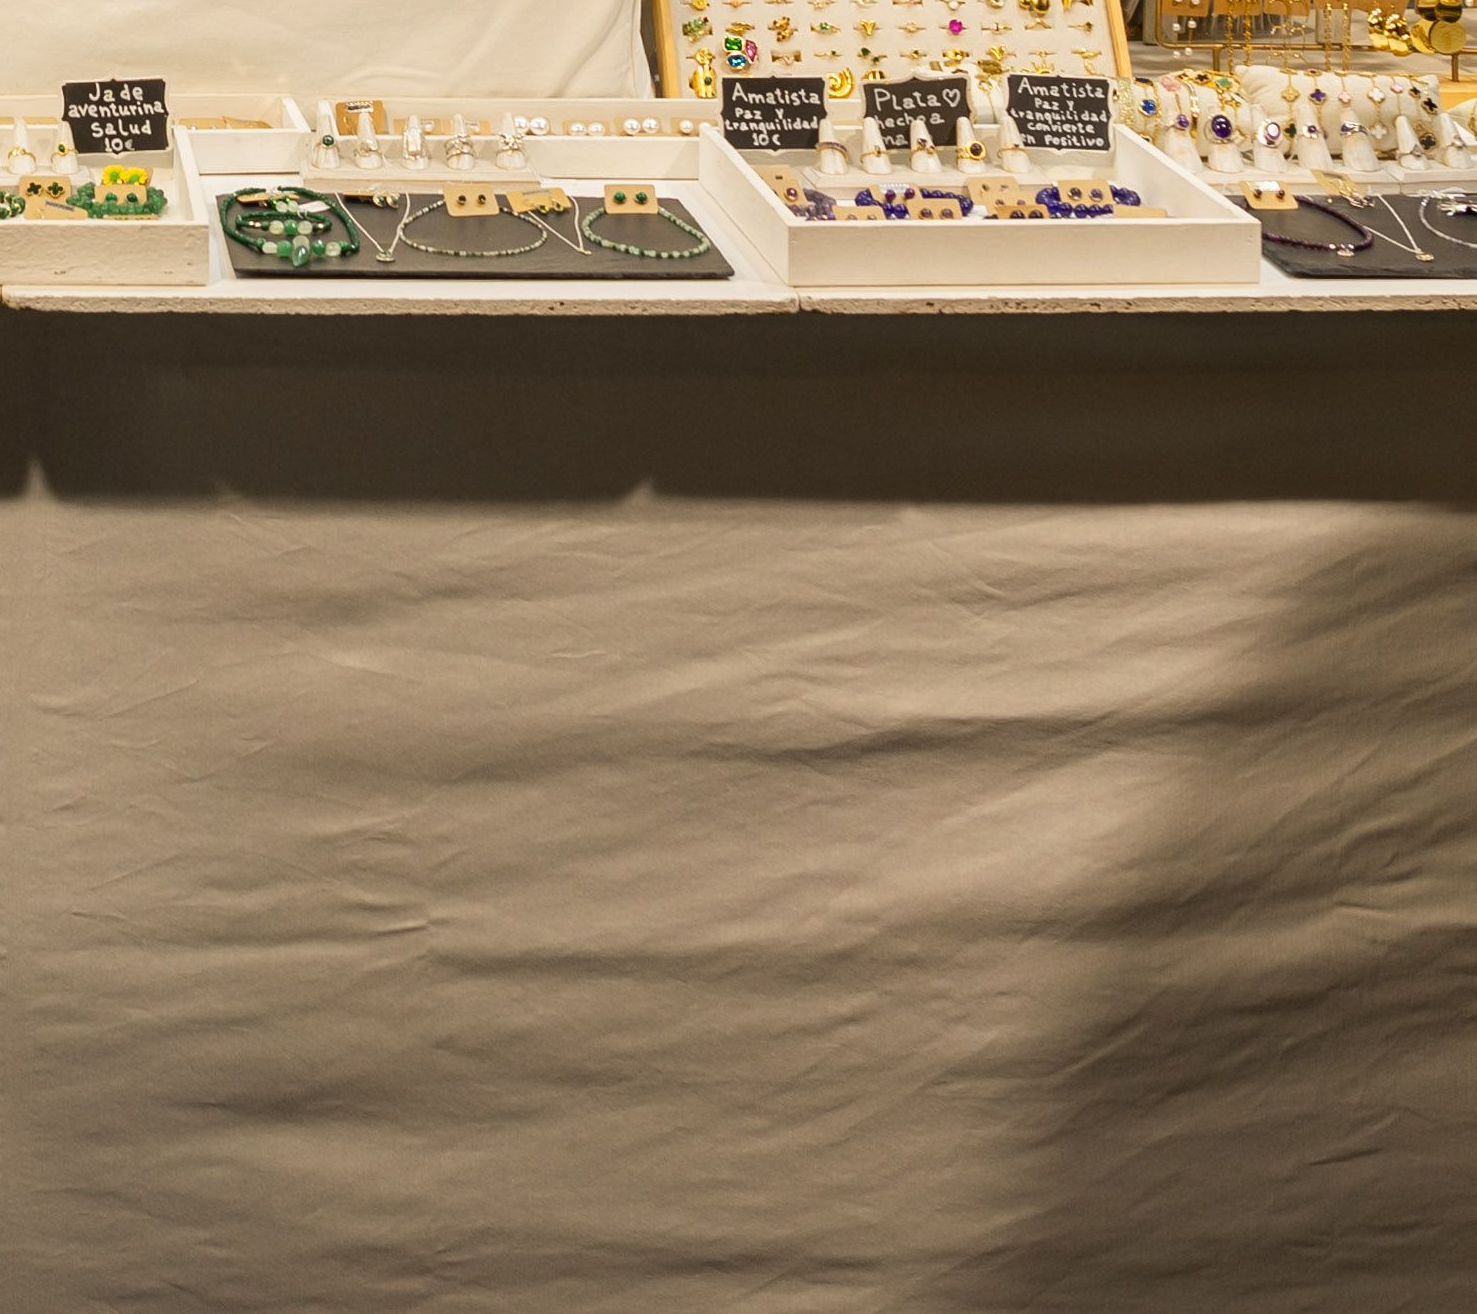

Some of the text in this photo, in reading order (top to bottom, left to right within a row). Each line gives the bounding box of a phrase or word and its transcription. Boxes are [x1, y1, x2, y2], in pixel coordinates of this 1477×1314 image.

[731, 81, 822, 106] Amatista
[1017, 76, 1106, 99] Amatista
[873, 87, 943, 112] Plata
[67, 100, 165, 119] aventurina
[1009, 107, 1108, 125] tranquilidad
[724, 116, 819, 135] tranquilidad
[1026, 121, 1096, 134] convierte
